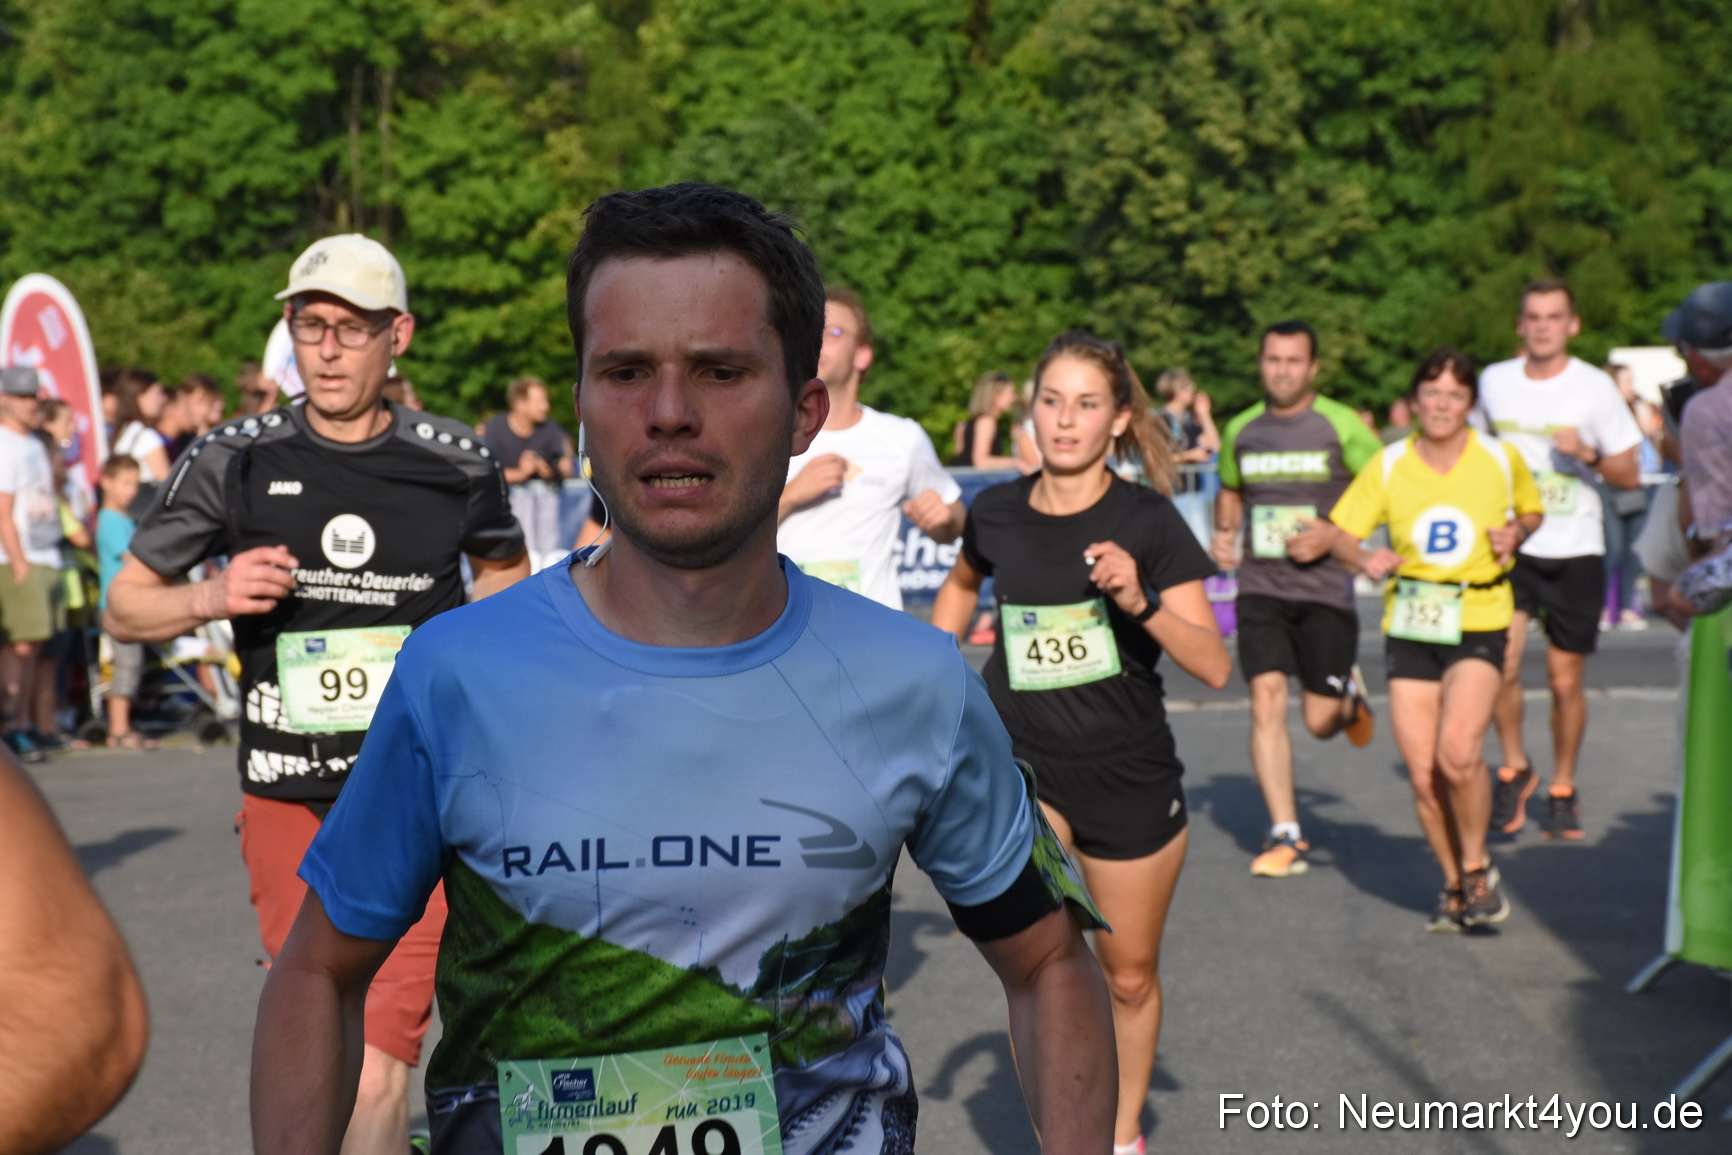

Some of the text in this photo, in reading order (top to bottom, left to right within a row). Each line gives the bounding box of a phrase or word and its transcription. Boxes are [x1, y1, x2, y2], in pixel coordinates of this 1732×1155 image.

[267, 480, 303, 495] JAKO
[1426, 520, 1458, 554] B
[290, 567, 436, 592] reuther+Deuerlein
[1026, 635, 1087, 665] 436
[320, 667, 368, 702] 99
[663, 1051, 751, 1067] Gesunde Firmen
[538, 1093, 638, 1120] firmenlauf
[665, 1092, 756, 1120] run 2019
